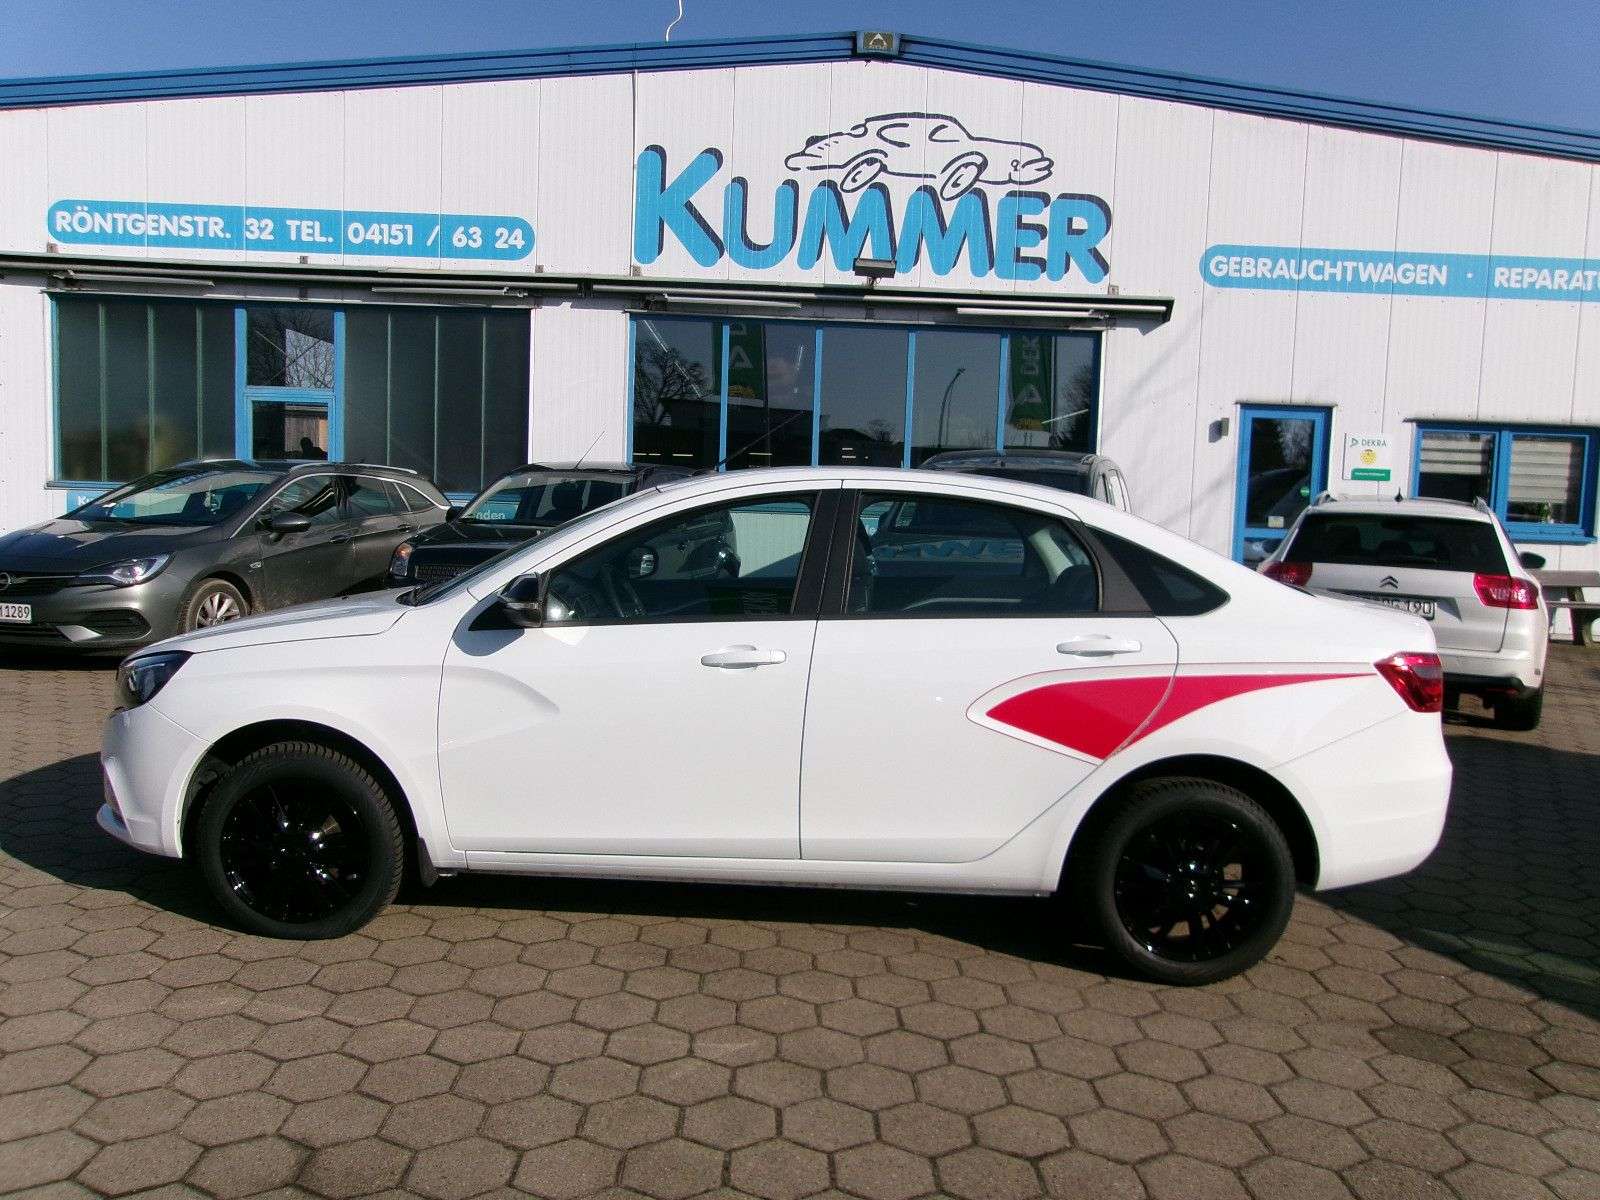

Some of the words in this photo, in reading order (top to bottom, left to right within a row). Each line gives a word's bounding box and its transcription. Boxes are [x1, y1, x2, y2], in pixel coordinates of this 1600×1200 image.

[55, 206, 232, 239] RÖNTGENSTR.
[245, 218, 274, 240] 32
[286, 219, 334, 243] TEL.
[347, 222, 414, 246] 04151
[426, 225, 440, 246] /
[452, 226, 483, 248] 63
[495, 228, 526, 250] 24
[633, 144, 1112, 284] KUMMER
[1209, 255, 1448, 286] GEBRAUCHTWAGEN
[1493, 267, 1600, 291] REPARAT
[1361, 438, 1387, 448] DEKRA
[4, 604, 30, 619] 1289
